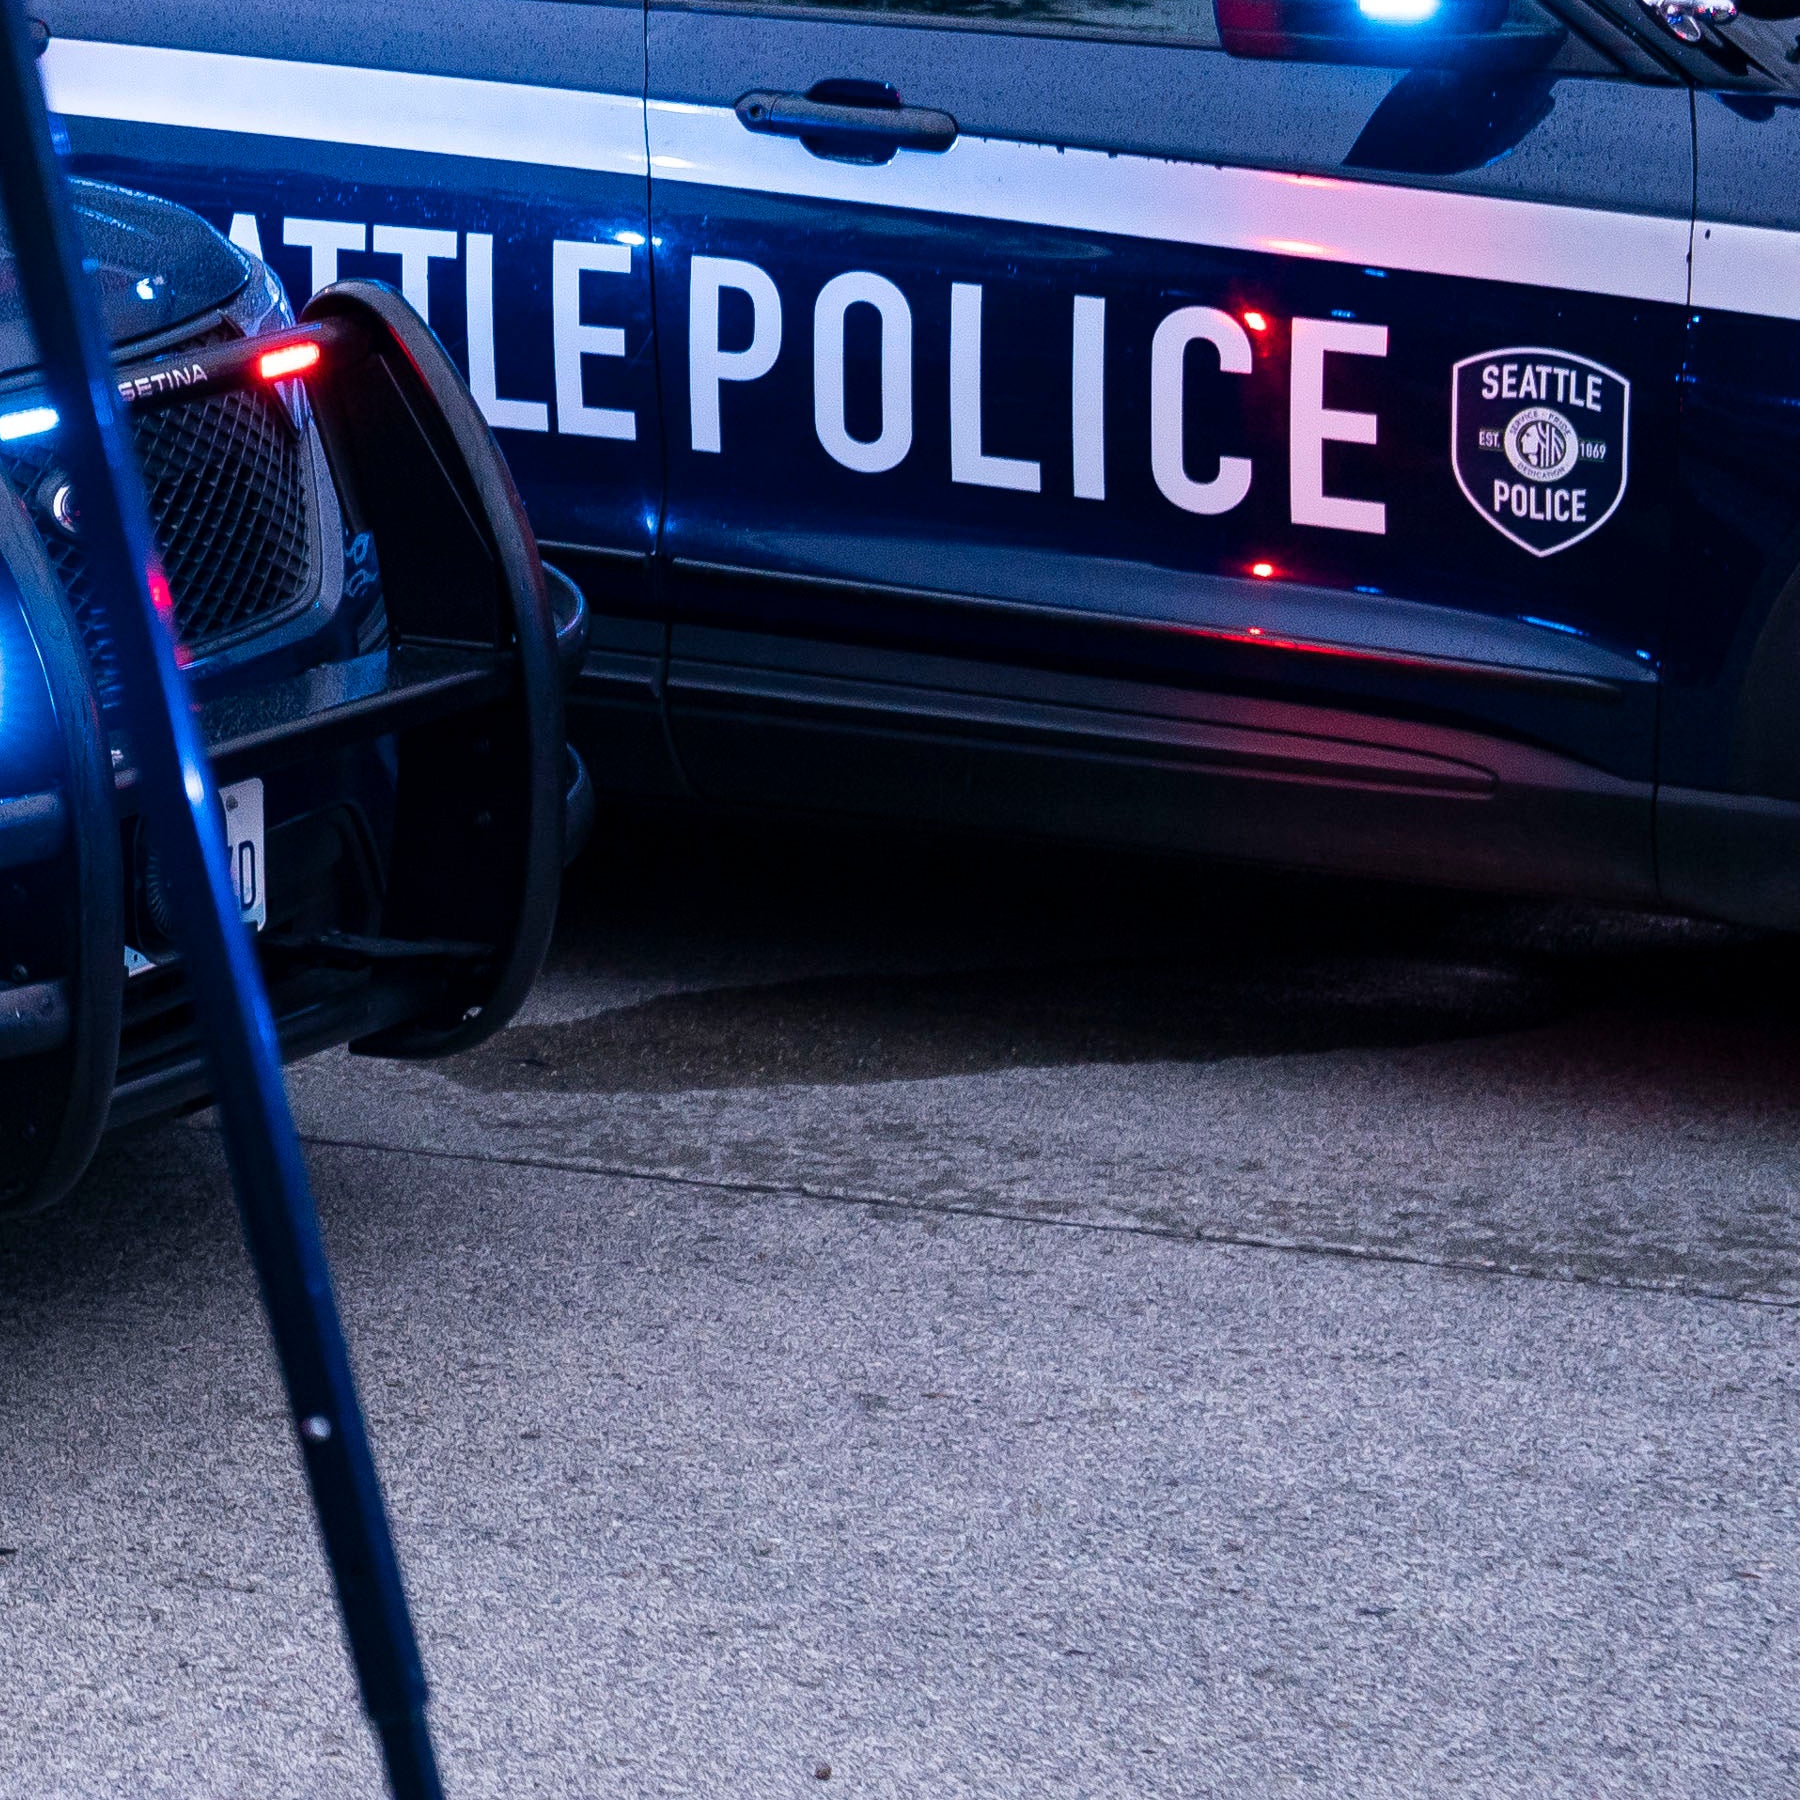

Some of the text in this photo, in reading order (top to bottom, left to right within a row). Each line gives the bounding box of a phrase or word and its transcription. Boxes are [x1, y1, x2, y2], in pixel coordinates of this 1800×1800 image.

[117, 363, 208, 401] SETINA
[689, 255, 1388, 535] POLICE
[1482, 364, 1602, 411] SEATTLE
[1479, 431, 1500, 448] EST.
[1493, 479, 1587, 523] POLICE
